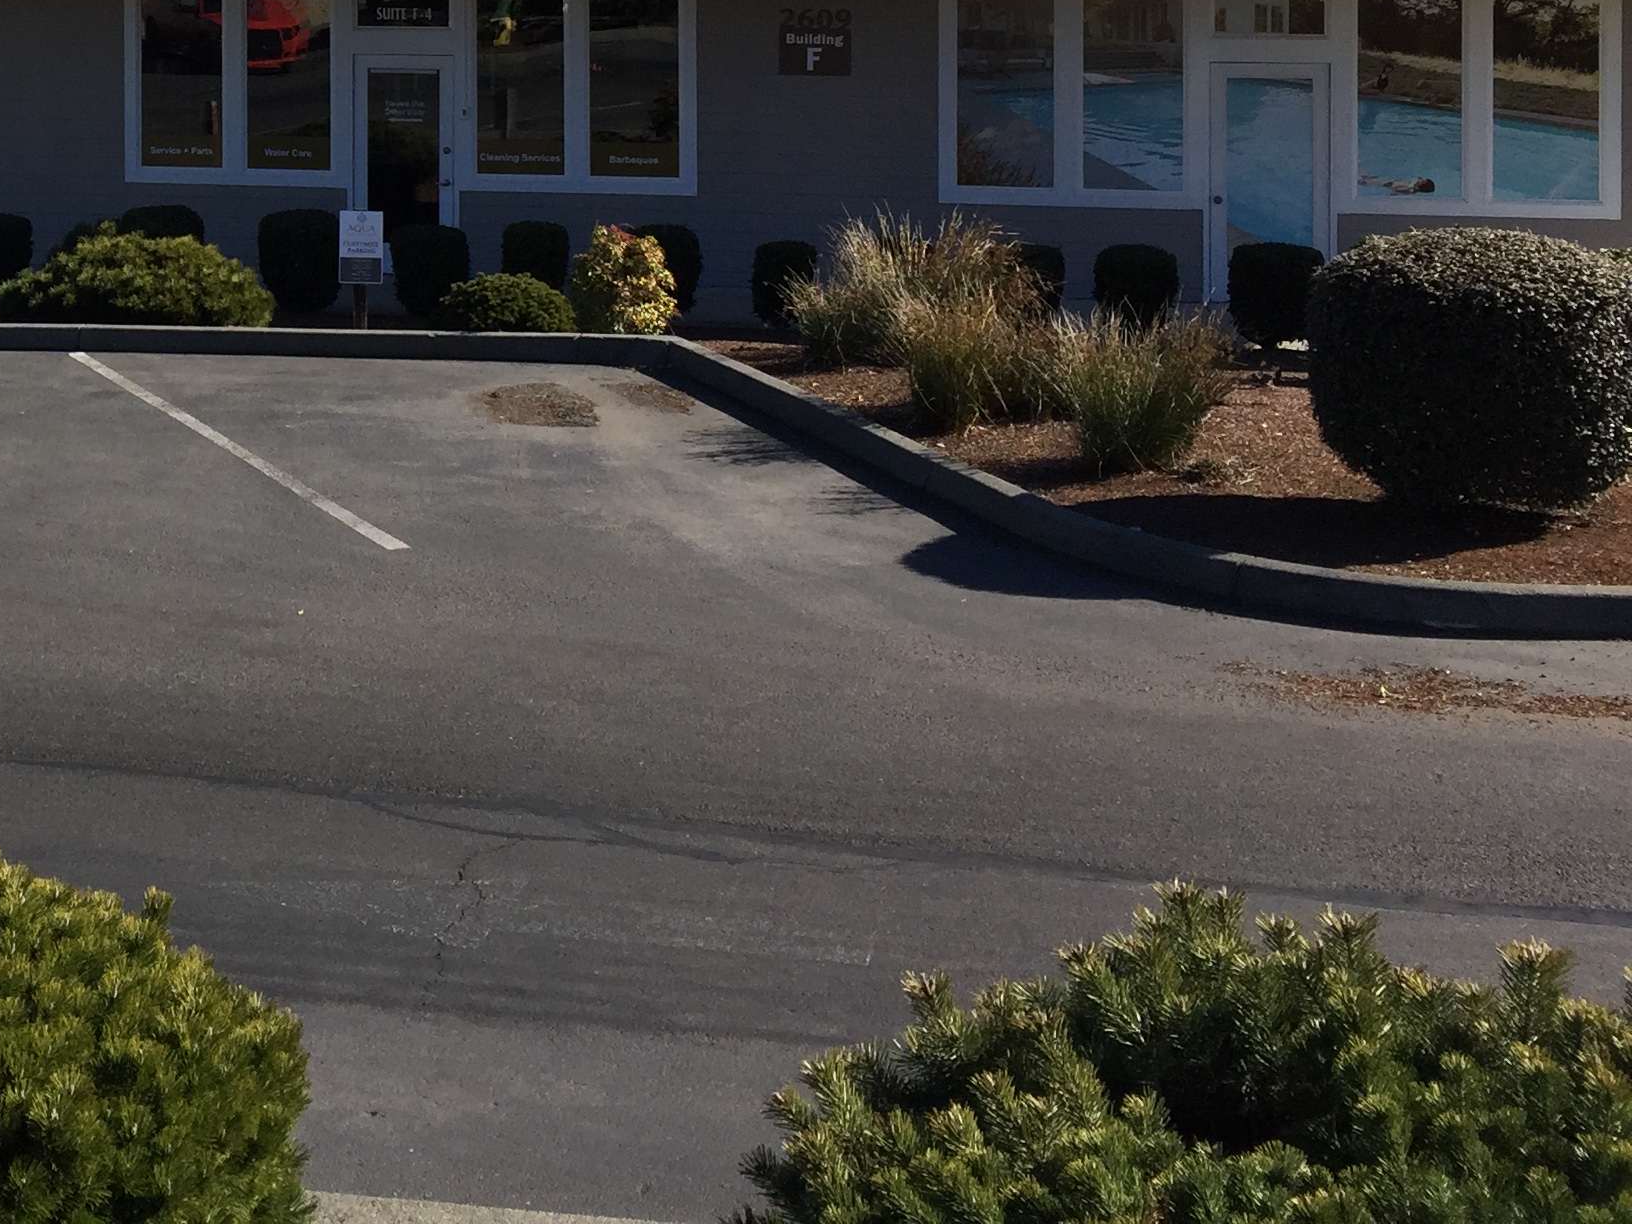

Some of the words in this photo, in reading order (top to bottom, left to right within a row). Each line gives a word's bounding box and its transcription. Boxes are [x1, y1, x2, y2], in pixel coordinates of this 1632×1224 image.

[376, 7, 407, 20] SUITE
[412, 7, 432, 21] F-4
[778, 8, 852, 30] 2609
[786, 32, 844, 47] Building
[806, 47, 822, 71] F
[149, 146, 181, 155] Service
[190, 147, 213, 156] Parts
[263, 148, 289, 157] Water
[291, 148, 313, 158] Care
[479, 152, 519, 163] Cleaning
[521, 153, 561, 163] Services
[608, 155, 660, 165] Barbeques
